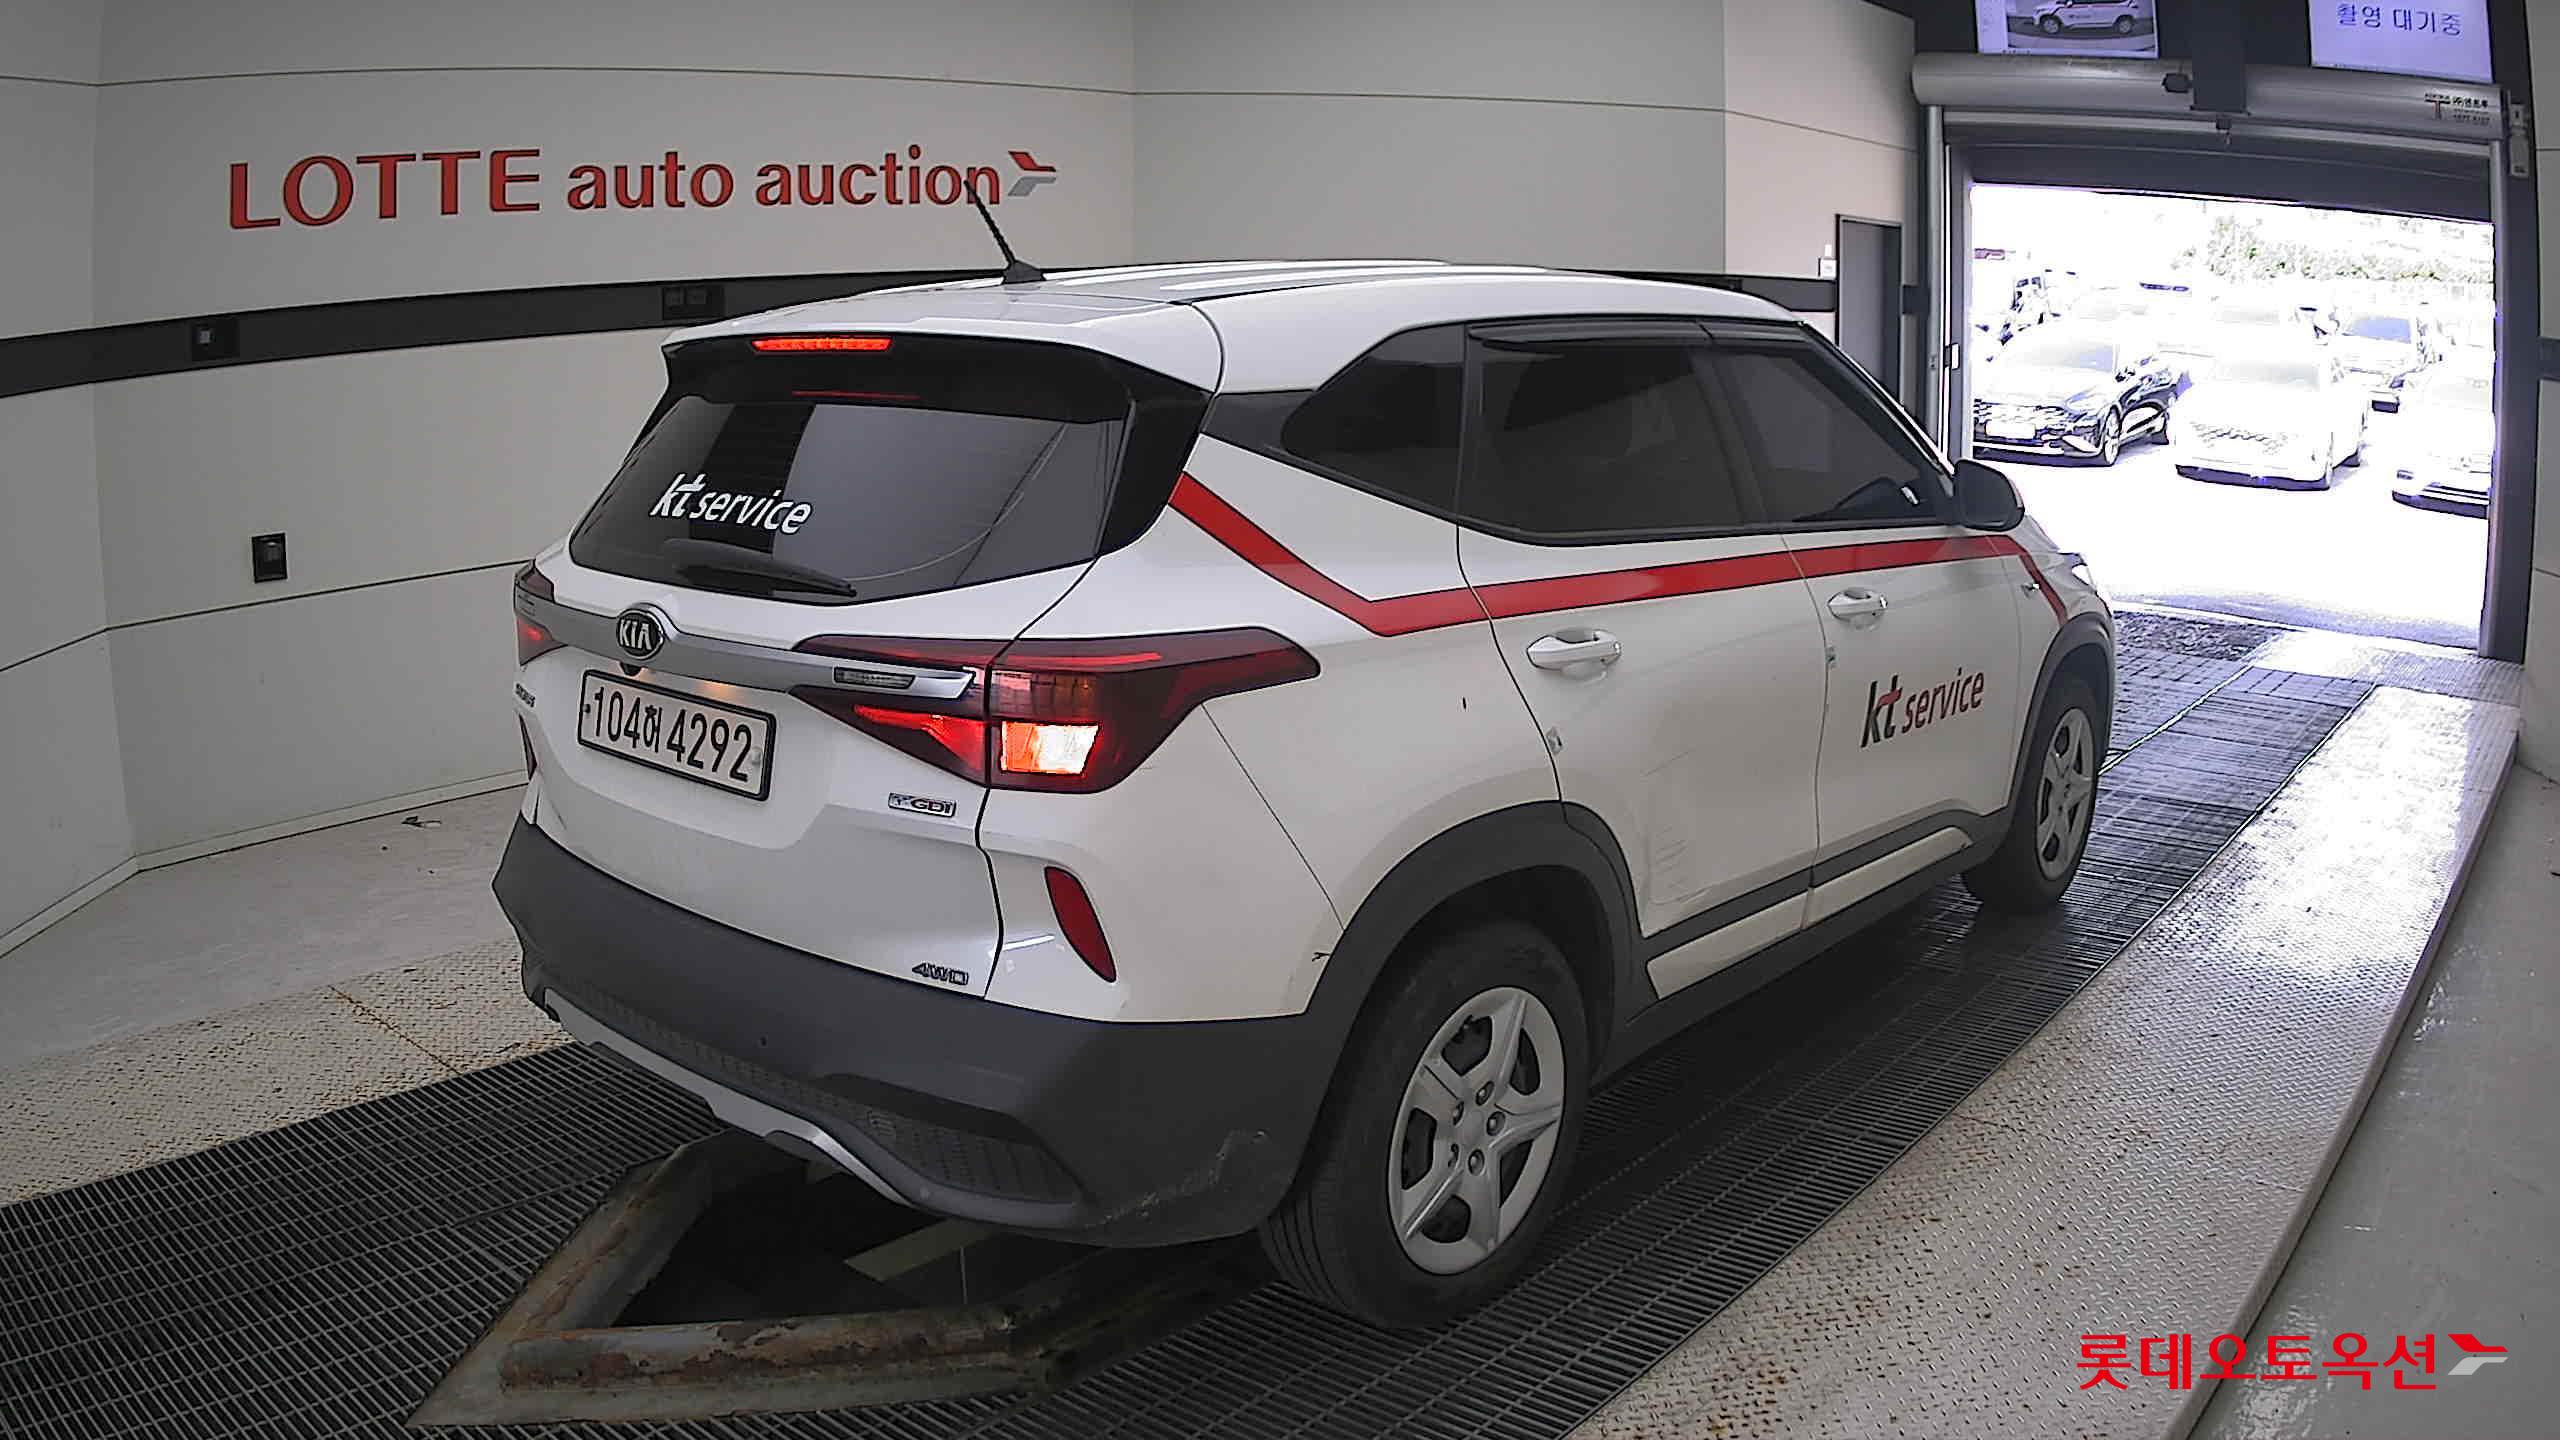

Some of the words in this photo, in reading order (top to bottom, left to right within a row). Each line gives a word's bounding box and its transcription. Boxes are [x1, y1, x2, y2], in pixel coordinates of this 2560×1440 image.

[2337, 3, 2383, 30] 촬영
[2392, 8, 2462, 37] 대기중
[229, 148, 541, 230] LOTTE
[566, 150, 735, 210] auto
[754, 144, 1001, 207] auction
[650, 473, 707, 517] kt
[689, 489, 813, 534] service
[619, 618, 653, 650] KIA
[1860, 674, 1902, 749] kt
[1901, 666, 1985, 734] service
[911, 961, 969, 986] 4WD
